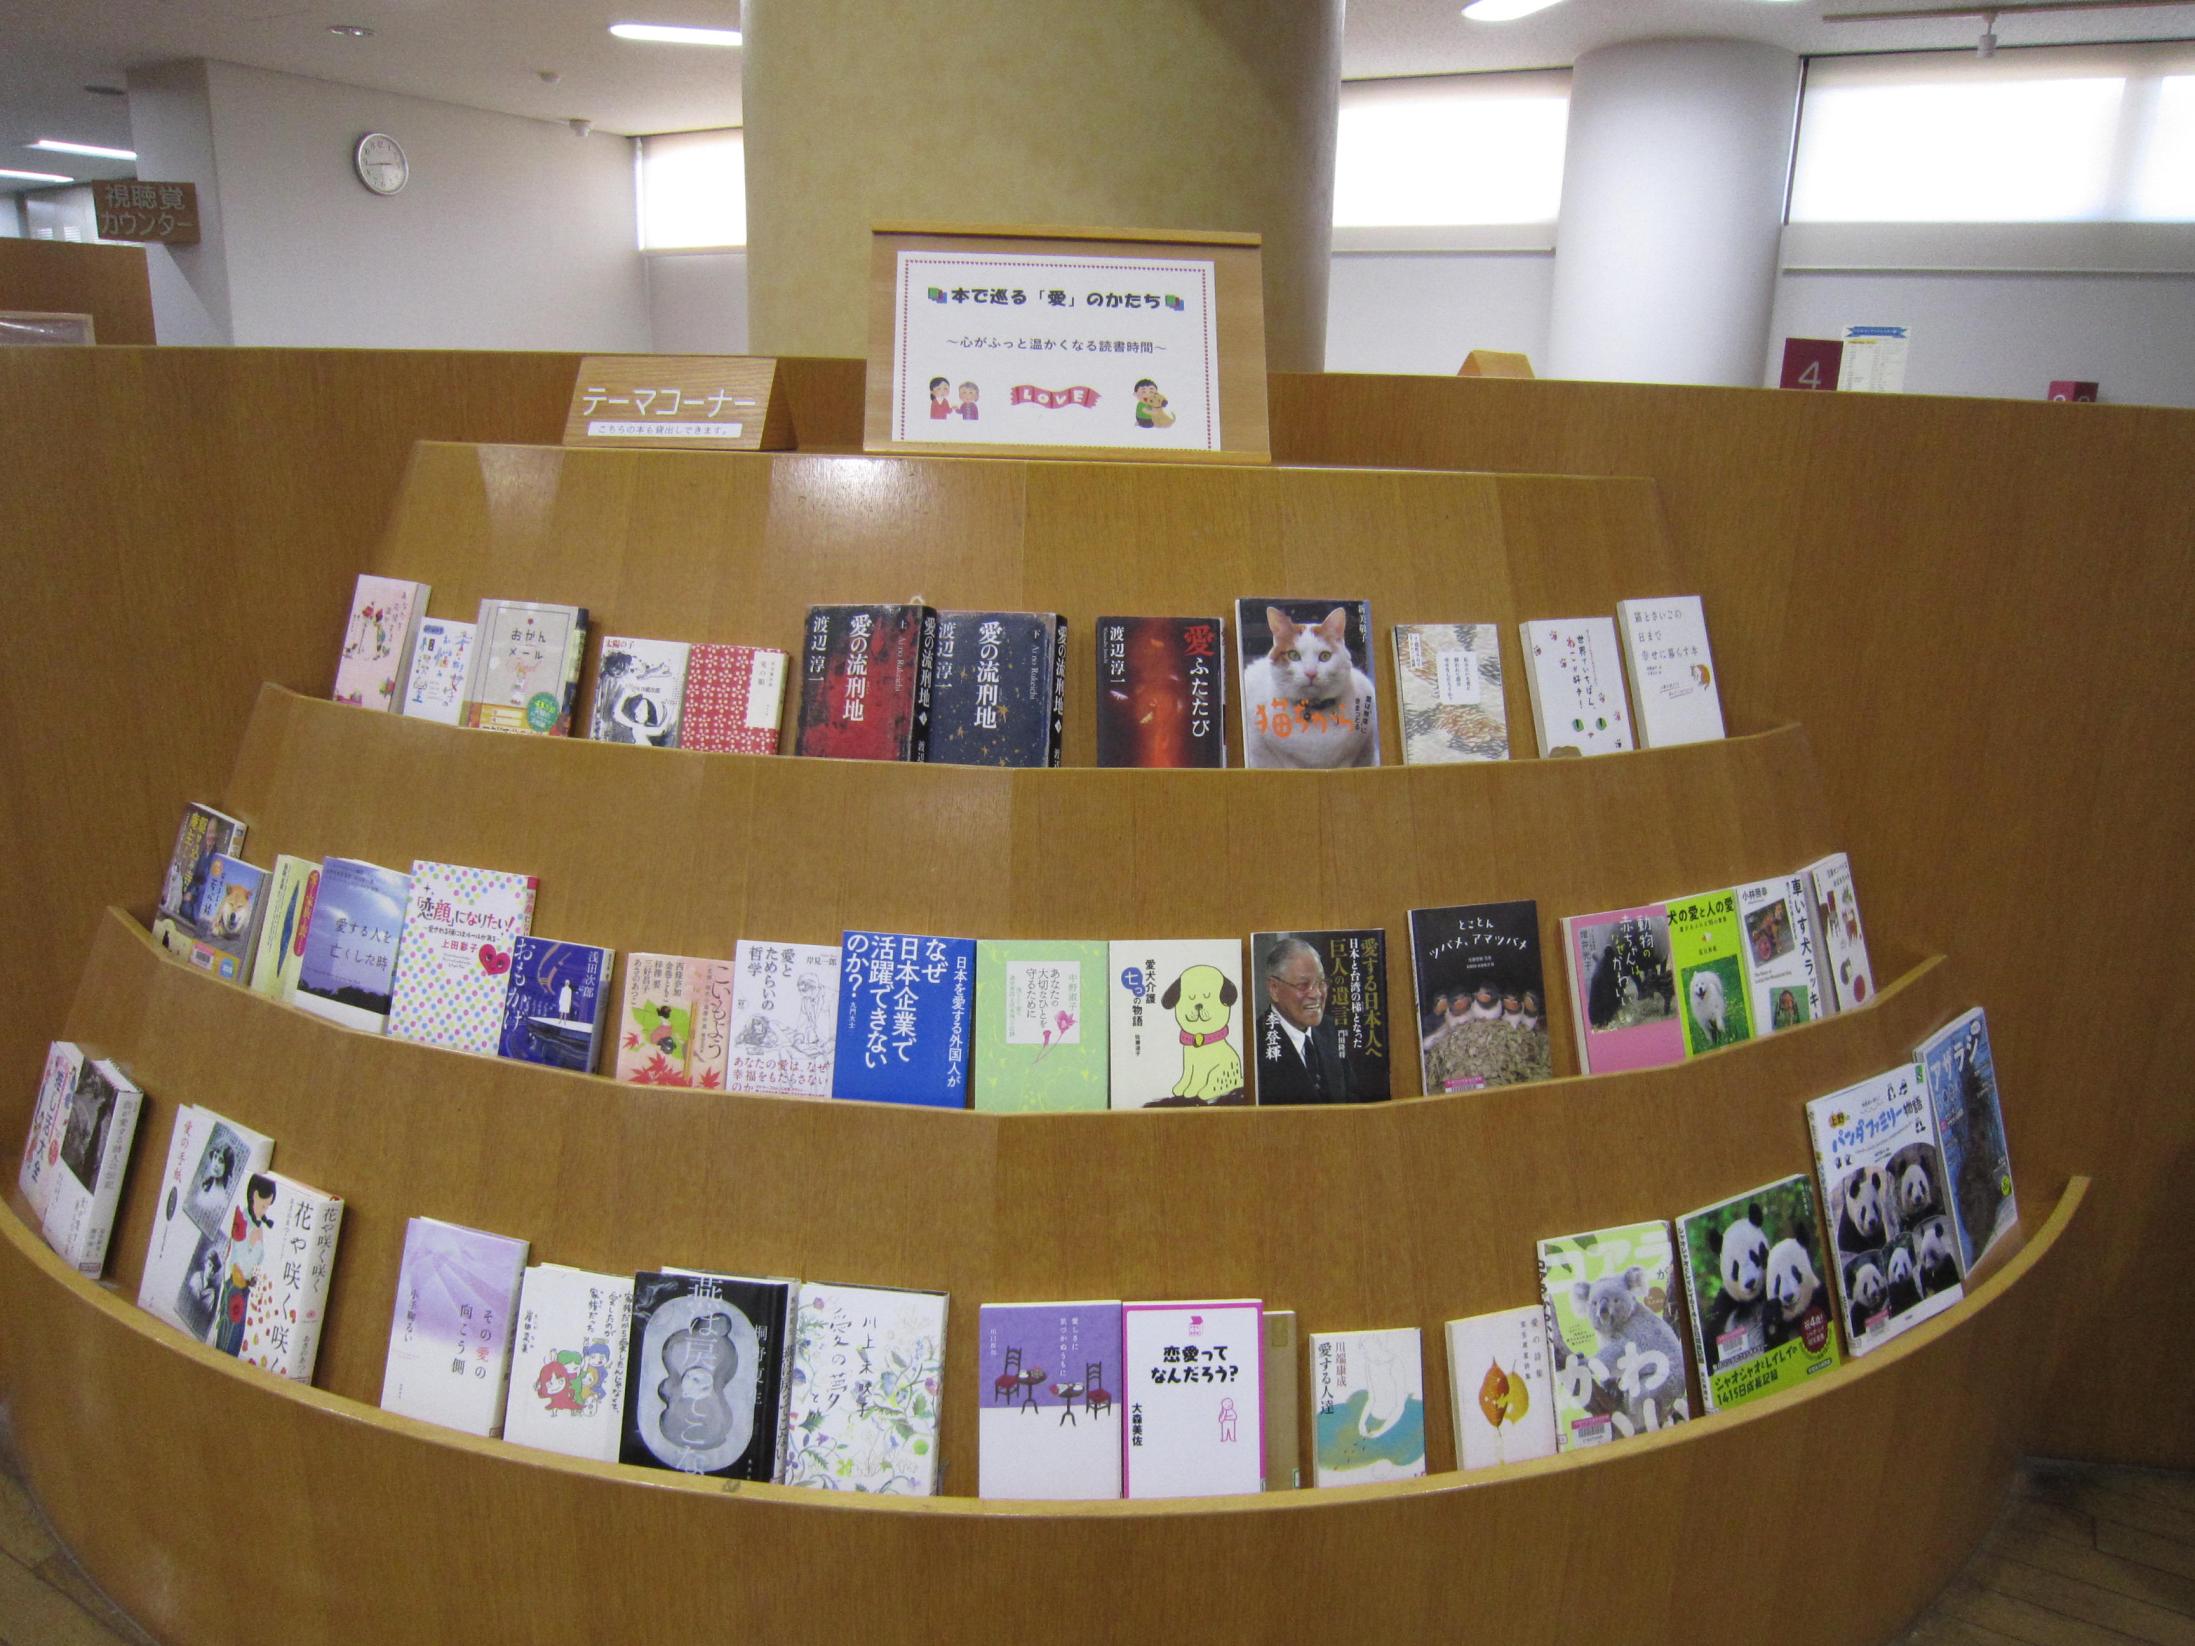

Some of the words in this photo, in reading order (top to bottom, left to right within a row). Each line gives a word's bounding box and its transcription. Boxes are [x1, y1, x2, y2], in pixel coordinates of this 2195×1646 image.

[105, 184, 185, 210] 視聴覚
[101, 211, 194, 235] カウンター
[951, 287, 1161, 310] 本で巡る「愛」のかたち
[1022, 388, 1085, 405] LOVE
[1798, 360, 1821, 390] 4
[582, 387, 756, 418] テーマコーナー
[508, 648, 544, 660] メール
[511, 629, 547, 643] おかん
[808, 615, 830, 682] 渡辺淳一
[1109, 625, 1127, 684] 渡辺淳一
[842, 613, 872, 722] 愛の流刑地
[918, 616, 936, 709] 愛の流刑地
[973, 621, 1003, 730] 愛の流刑地
[1053, 625, 1067, 716] 愛の流刑地
[1183, 624, 1216, 737] 愛ふたたび
[335, 917, 392, 944] 愛する人を
[1458, 916, 1494, 931] とことん
[1637, 914, 1655, 958] 動物の
[1666, 896, 1735, 927] 犬の愛と人の愛
[329, 943, 389, 972] 亡くした時
[748, 946, 763, 977] 哲学
[781, 948, 796, 978] 愛と
[806, 956, 838, 967] 岸見一郎
[921, 938, 947, 984] なぜ
[1790, 877, 1820, 1020] 車いす犬ラッキー
[582, 950, 600, 999] 浅田次郎
[761, 946, 779, 1011] ためらいの
[1025, 967, 1037, 1018] 守るために
[1038, 967, 1049, 1029] 大切なひとを
[1050, 968, 1061, 1007] あなたの
[1329, 938, 1349, 1026] 巨人の遺言
[1360, 939, 1383, 1058] 愛する日本人へ
[865, 935, 897, 1069] 活躍できない
[892, 936, 921, 1063] 日本企業で
[947, 956, 968, 1089] 日本を愛する外国人が
[1264, 1012, 1283, 1062] 李登輝
[311, 1207, 338, 1293] 花や咲く咲く
[1544, 1230, 1673, 1296] コアラ
[452, 1303, 473, 1376] 向こう側
[474, 1309, 493, 1379] その愛の
[1163, 1345, 1229, 1363] 恋愛って
[1150, 1364, 1240, 1384] なんだろう?
[1317, 1341, 1336, 1415] 愛する人達
[1335, 1341, 1347, 1388] 川端康成
[1131, 1402, 1143, 1447] 大森美佐
